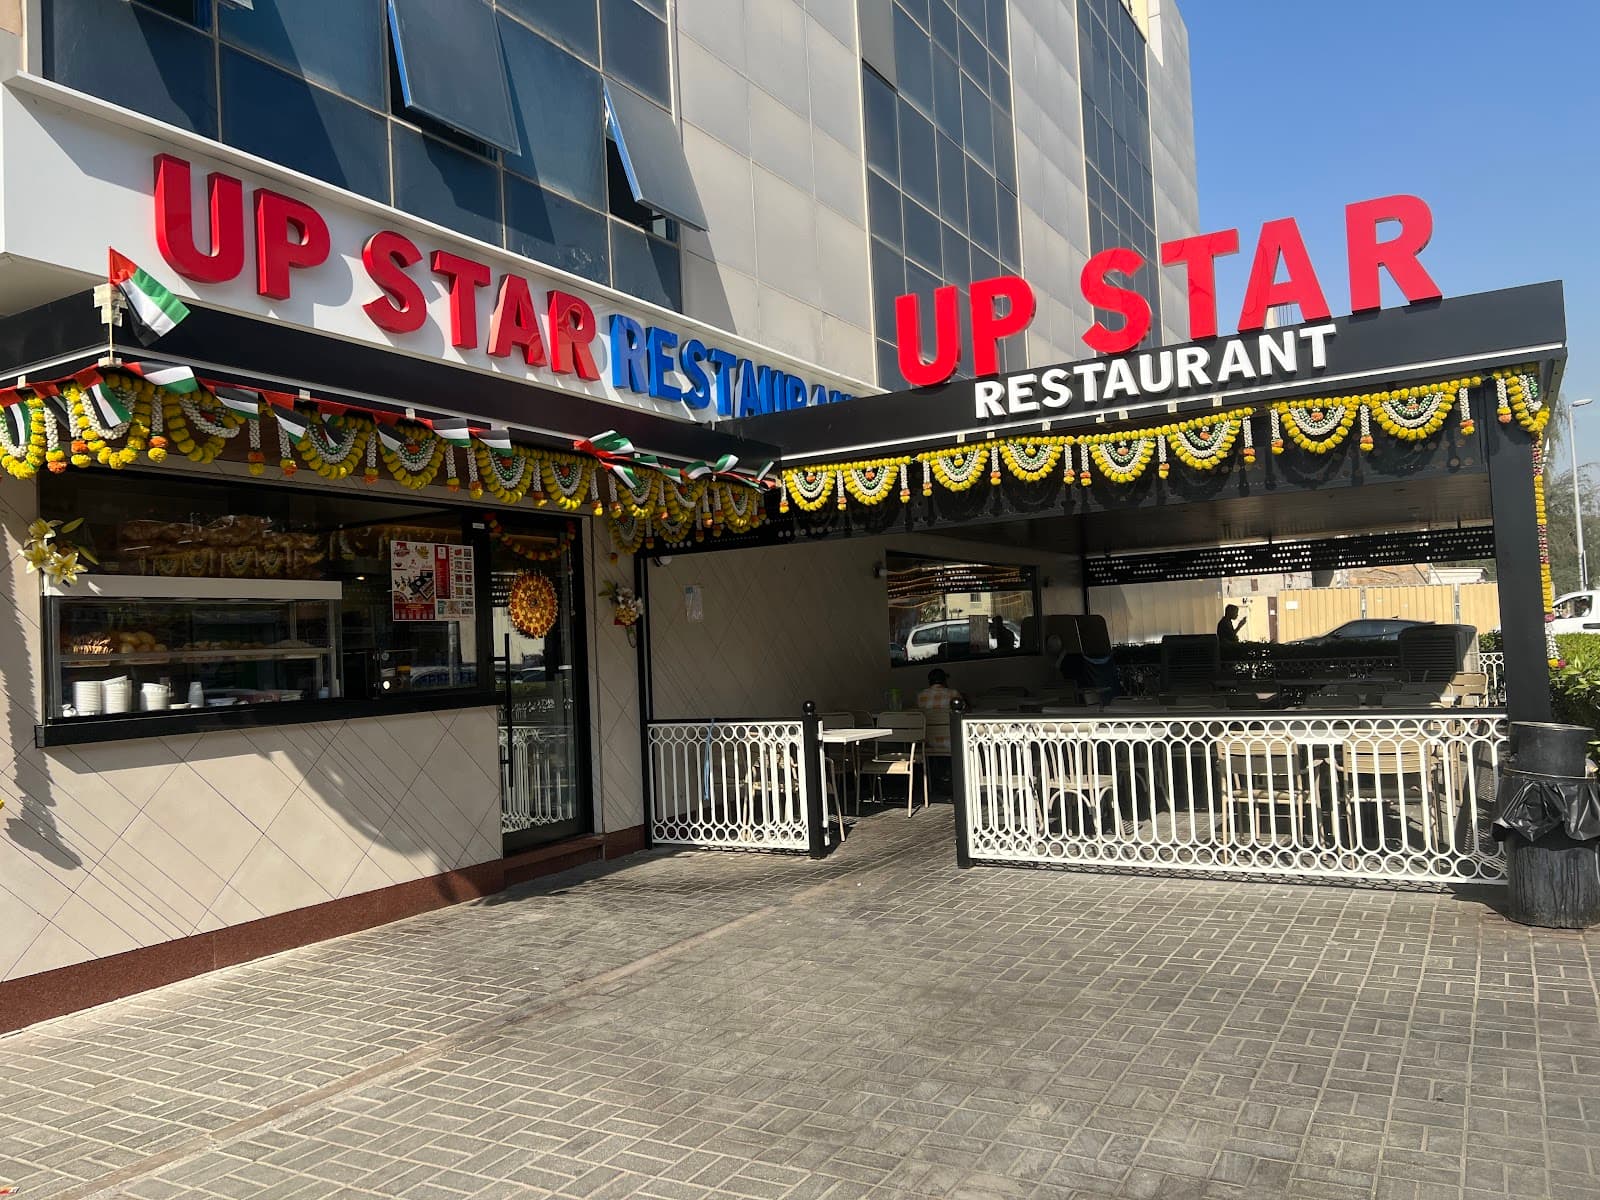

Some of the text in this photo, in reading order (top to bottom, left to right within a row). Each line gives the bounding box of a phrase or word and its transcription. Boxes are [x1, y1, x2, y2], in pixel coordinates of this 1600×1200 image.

[153, 153, 856, 418] UP STAR RESTAUR
[895, 194, 1443, 386] UP STAR
[974, 323, 1337, 420] RESTAURANT
